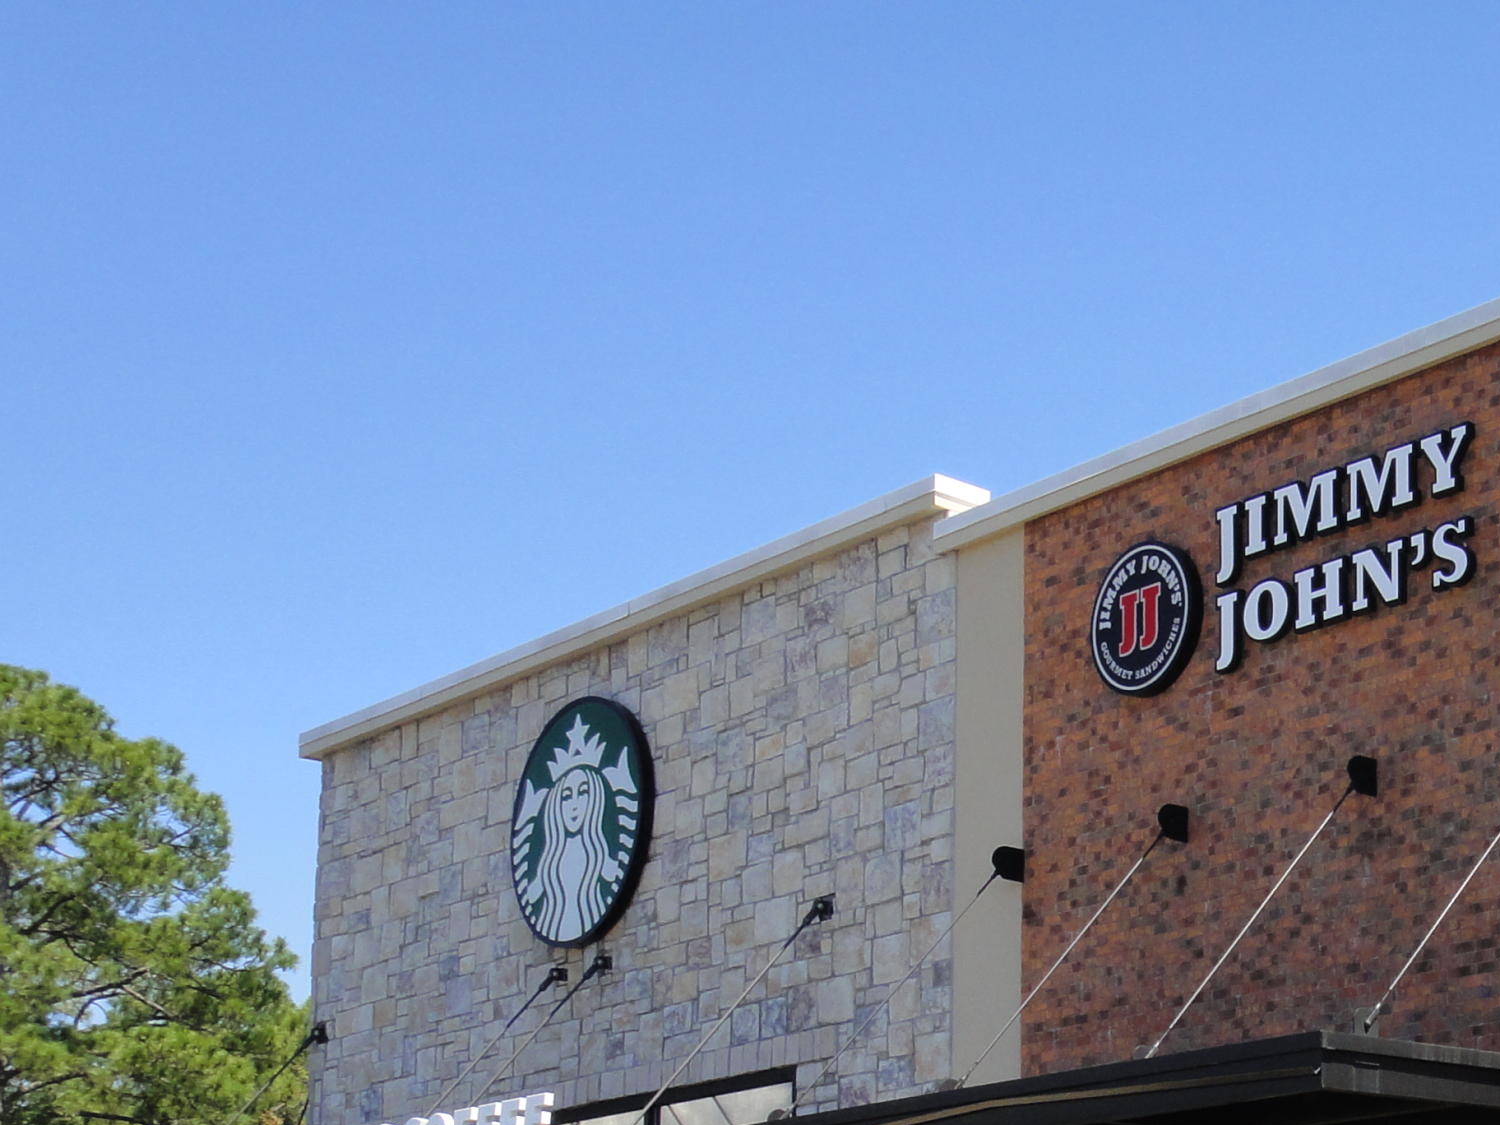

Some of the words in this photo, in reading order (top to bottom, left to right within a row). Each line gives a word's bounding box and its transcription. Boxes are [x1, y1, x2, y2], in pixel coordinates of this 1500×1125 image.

[1216, 423, 1472, 585] JIMMY
[1099, 559, 1137, 630] JIMMY
[1140, 555, 1182, 607] JOHN'S
[1119, 582, 1162, 658] JJ
[1216, 518, 1472, 671] JOHN'S
[1101, 641, 1133, 680] GOURMET
[1134, 617, 1181, 680] SANDWICHES
